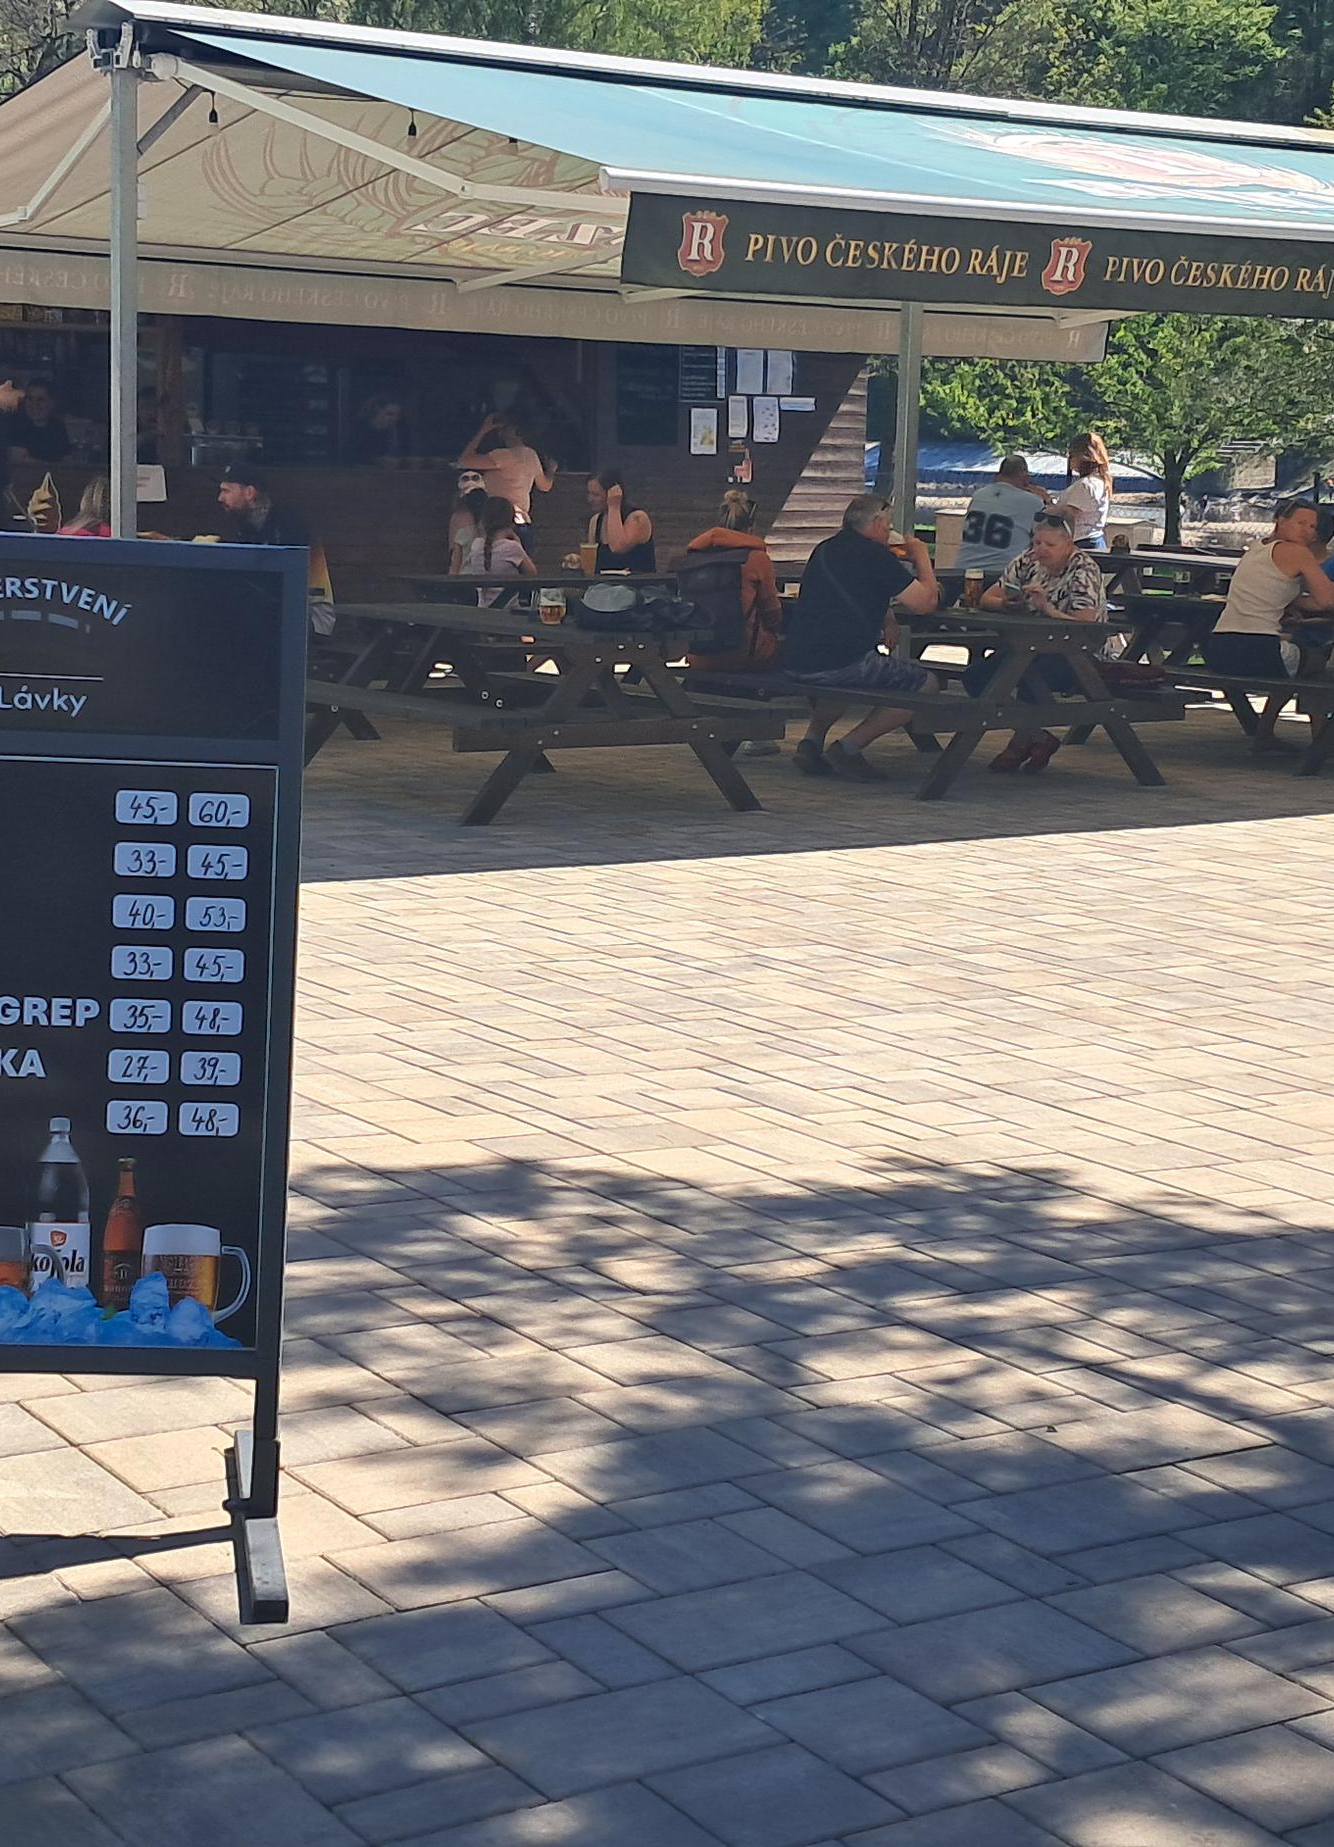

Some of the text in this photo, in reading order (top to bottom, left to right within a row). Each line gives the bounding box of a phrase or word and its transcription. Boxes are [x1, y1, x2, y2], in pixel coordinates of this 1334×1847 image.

[687, 221, 715, 261] R
[745, 233, 818, 265] PIVO
[825, 233, 961, 275] ČESKÉHO
[966, 245, 1030, 284] RÁJE
[1050, 246, 1079, 282] R
[1103, 255, 1165, 286] PIVO
[1170, 255, 1290, 292] ČESKÉHO
